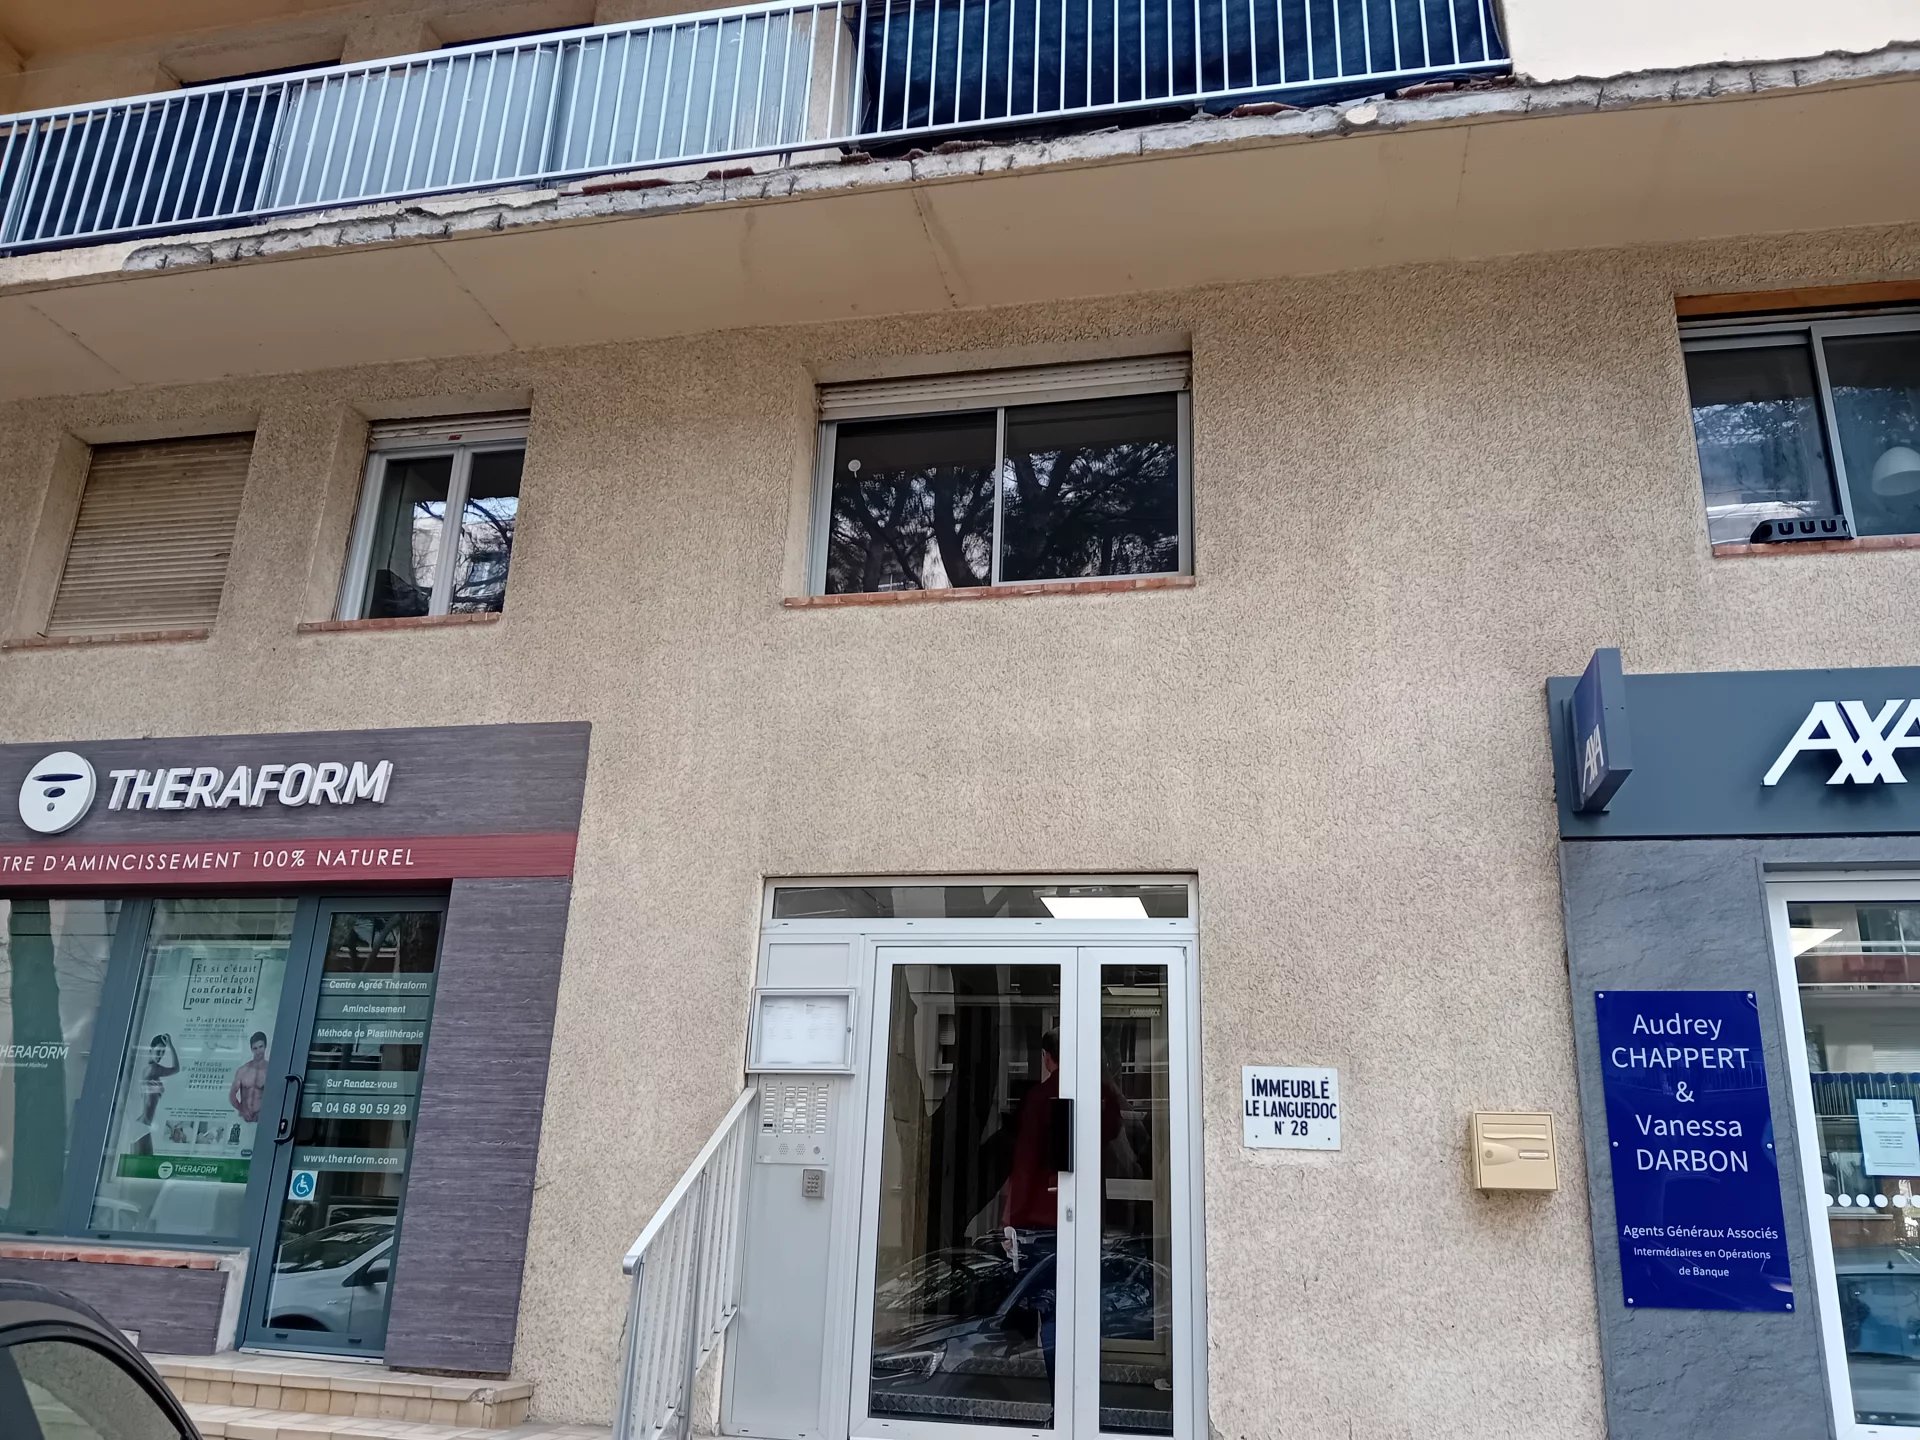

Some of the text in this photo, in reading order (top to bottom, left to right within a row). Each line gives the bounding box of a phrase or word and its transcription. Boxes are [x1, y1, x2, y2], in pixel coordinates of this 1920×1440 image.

[1582, 723, 1605, 793] AXA
[108, 760, 393, 811] THERAFORM
[43, 852, 241, 872] D'AMINCISSEMENT
[252, 850, 306, 868] 100%
[316, 848, 415, 866] NATUREL
[196, 964, 207, 973] Et
[205, 974, 228, 984] seule
[329, 980, 428, 990] Centre Agréé Théraform
[192, 986, 253, 994] confortable
[189, 997, 211, 1006] pour
[214, 996, 243, 1005] mincir
[342, 1004, 406, 1014] Amincissement
[1632, 1012, 1722, 1040] Audrey
[317, 1028, 424, 1040] Méthode de Plastithérapie
[0, 1044, 70, 1060] HERAFORM
[1611, 1047, 1750, 1069] CHAPPERT
[326, 1078, 398, 1089] Sur Rendez-vous
[1252, 1078, 1330, 1099] IMMEUBLE
[1675, 1081, 1694, 1102] &
[326, 1102, 407, 1115] 04 68 90 59 29
[1245, 1100, 1338, 1120] LE LANGUEDOC
[1290, 1120, 1308, 1136] 28
[1634, 1114, 1743, 1137] Vanessa
[303, 1154, 398, 1165] www.theraform.com
[1636, 1148, 1749, 1172] DARBON
[174, 1164, 218, 1174] THERAFORM
[1623, 1224, 1778, 1240] Agents Généraux Associés
[1634, 1247, 1702, 1258] Intermédiaires
[1718, 1248, 1771, 1260] Opérations
[1678, 1266, 1730, 1278] de Banque
